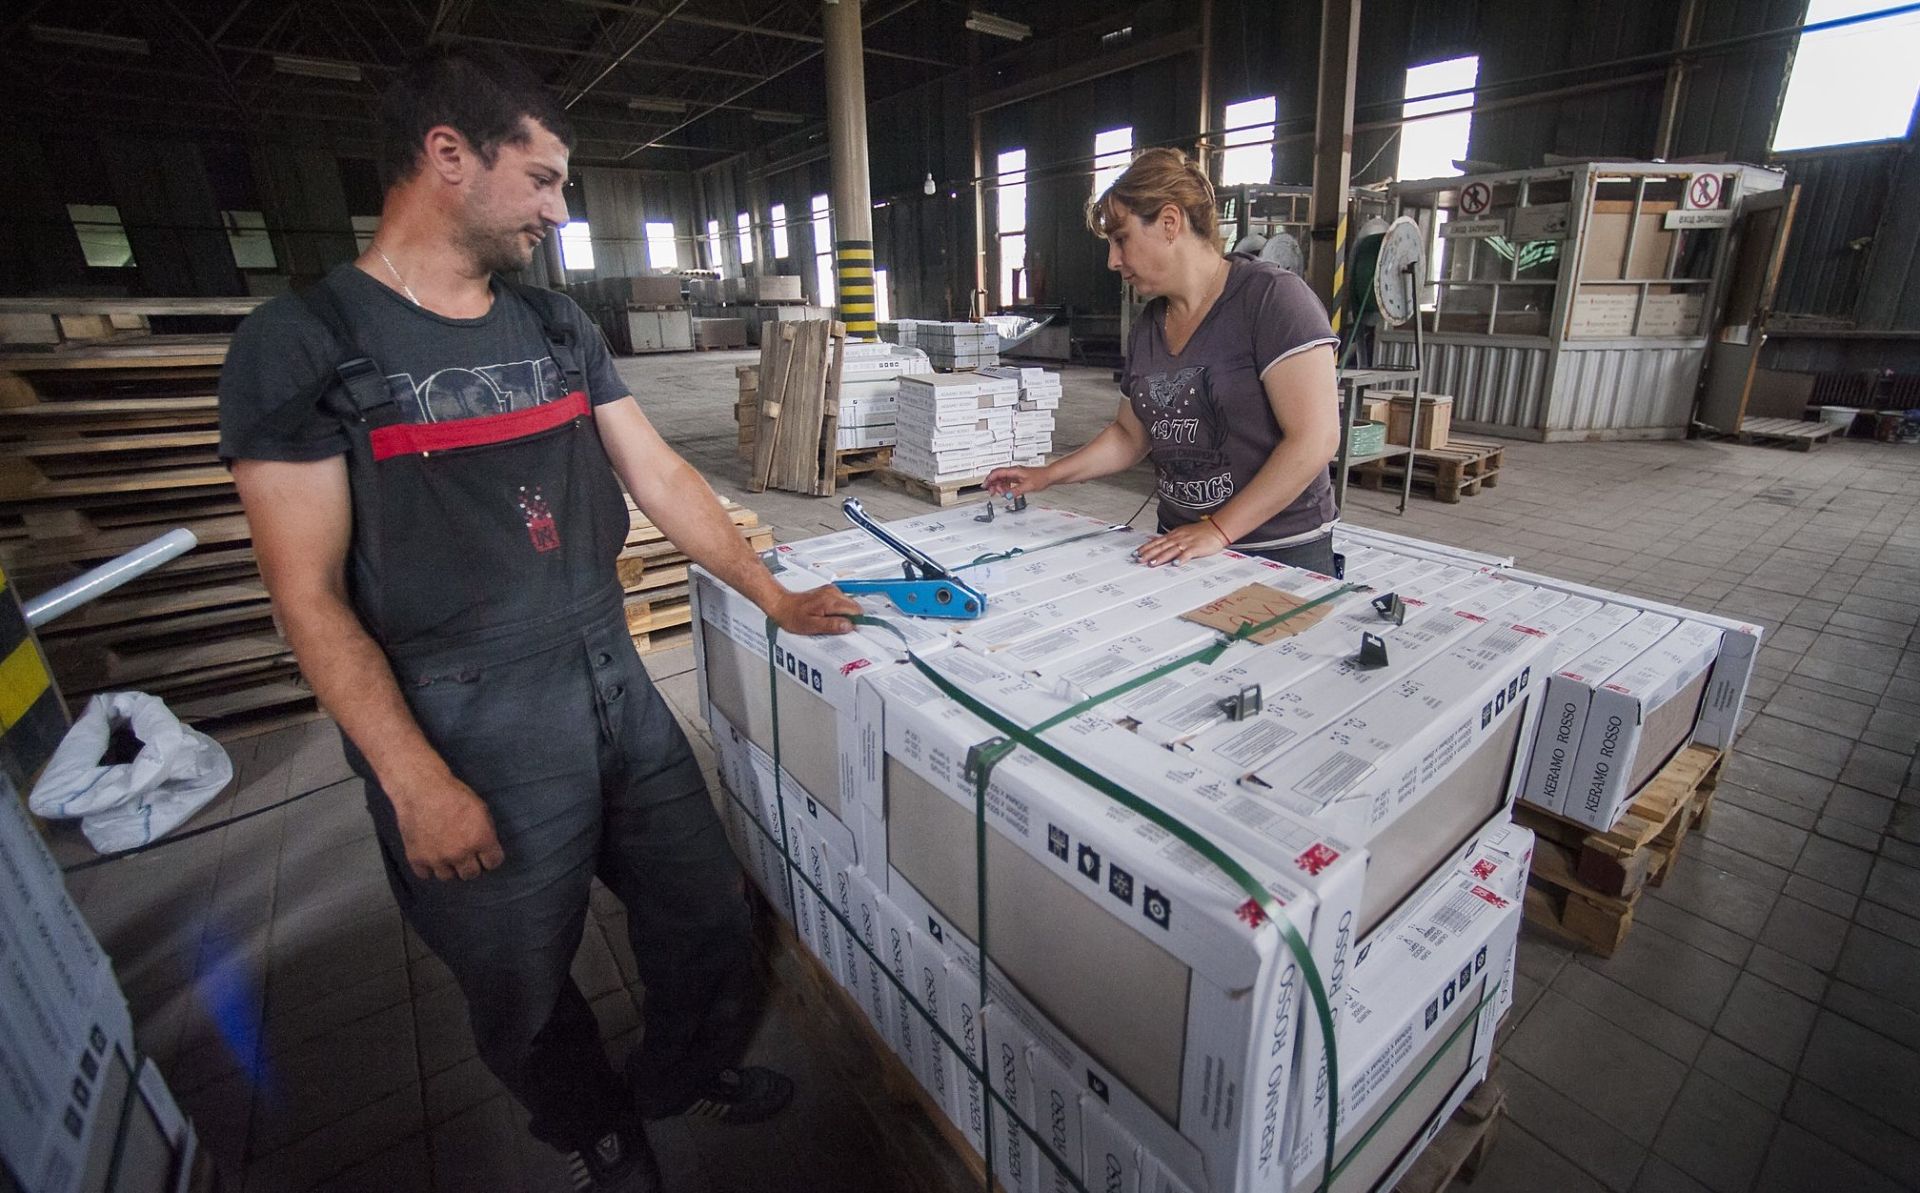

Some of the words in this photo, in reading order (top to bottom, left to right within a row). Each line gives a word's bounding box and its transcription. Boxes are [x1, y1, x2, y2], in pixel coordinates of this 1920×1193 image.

[1151, 418, 1199, 443] 1977
[1159, 470, 1234, 503] ASSICS
[1200, 598, 1234, 616] LOFT
[1543, 748, 1566, 798] KERAMO
[1556, 702, 1577, 744] ROSSO
[1584, 762, 1609, 814] KERAMO
[1600, 715, 1623, 759] ROSSO
[1328, 910, 1352, 1000] ROSSO
[961, 1003, 976, 1063] ROSSO
[1258, 1063, 1284, 1171] KERAMO
[1271, 963, 1296, 1058] ROSSO
[967, 1069, 982, 1137] KERAMO
[1002, 1043, 1017, 1108] ROSSO
[1008, 1113, 1022, 1184] KERAMO
[1051, 1089, 1067, 1157] ROSSO
[1106, 1152, 1122, 1193] SSO
